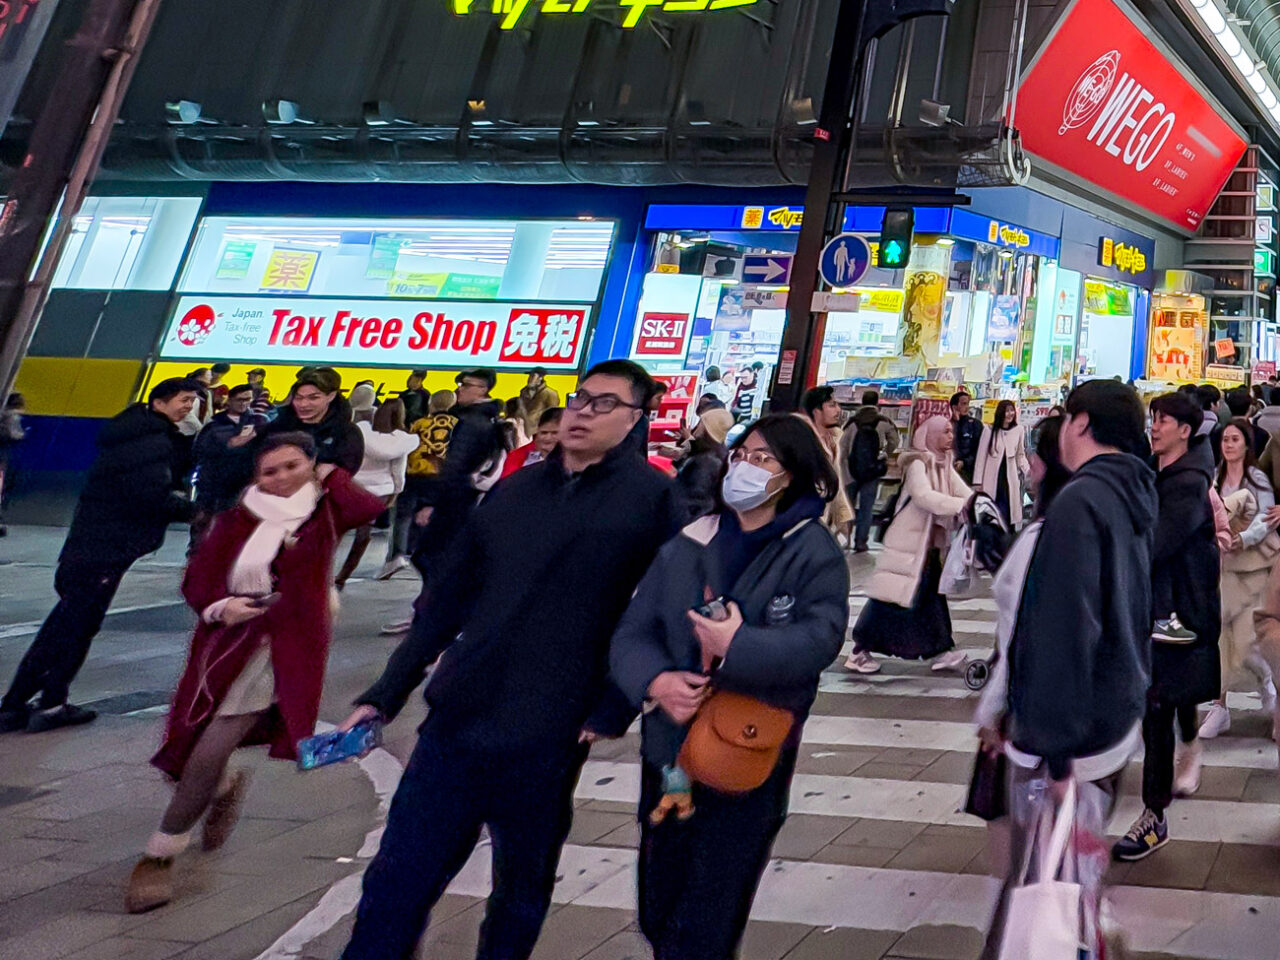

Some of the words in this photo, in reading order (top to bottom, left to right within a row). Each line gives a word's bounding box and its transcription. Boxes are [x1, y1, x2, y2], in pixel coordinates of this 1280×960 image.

[1086, 72, 1177, 172] WEGO
[267, 251, 309, 290] 薬
[233, 335, 258, 345] Shop
[267, 309, 326, 347] Tax
[327, 310, 402, 350] Free
[408, 312, 497, 355] Shop
[503, 312, 581, 358] 免税
